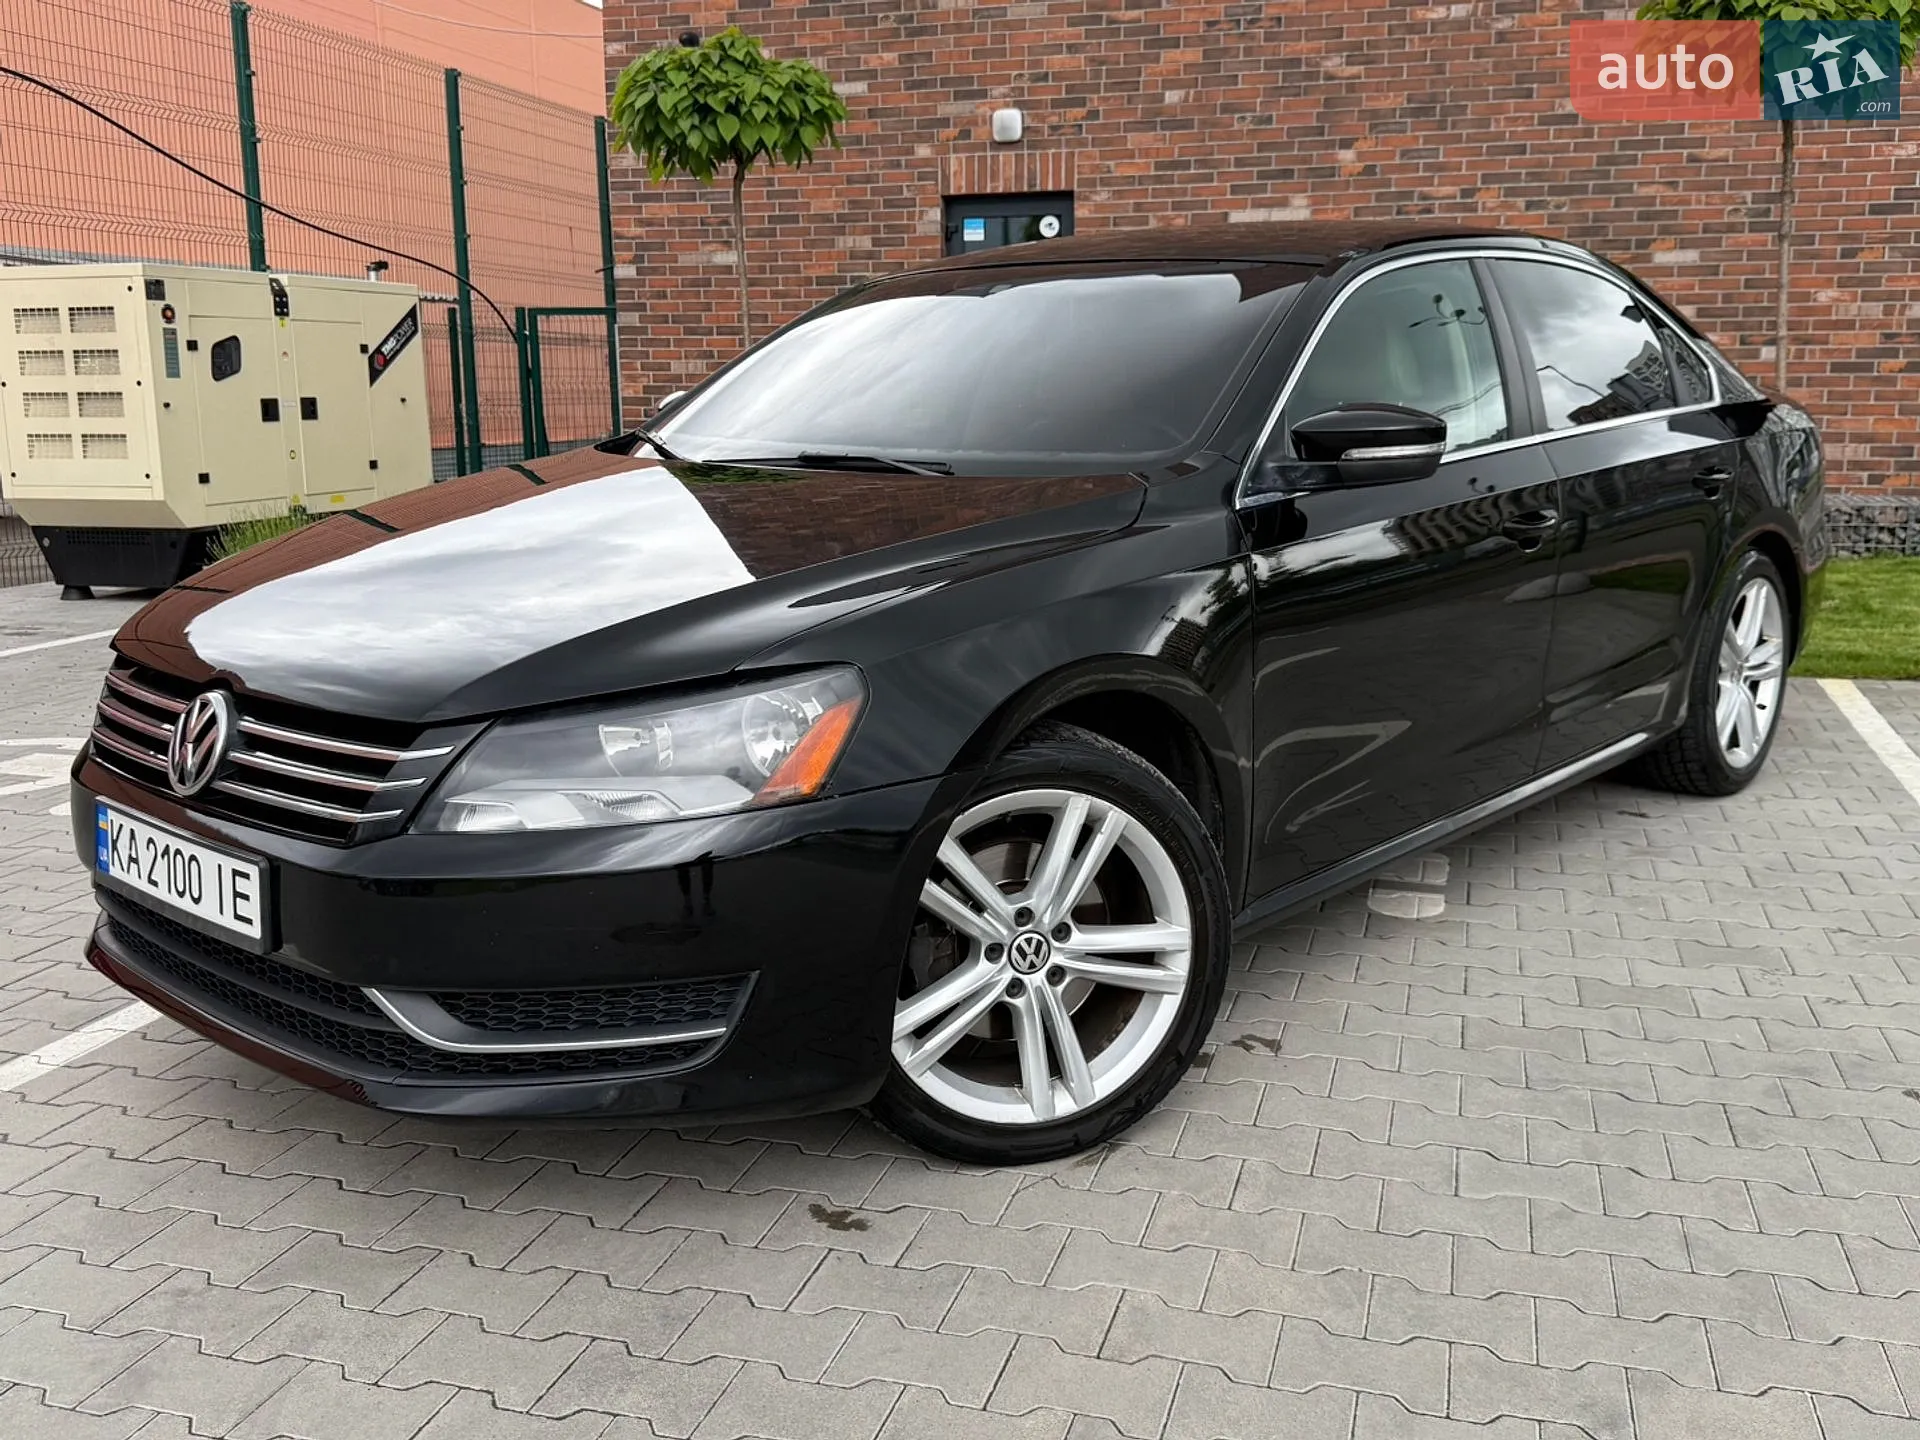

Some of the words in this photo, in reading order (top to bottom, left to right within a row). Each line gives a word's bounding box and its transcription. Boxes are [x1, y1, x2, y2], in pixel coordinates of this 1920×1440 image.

[110, 819, 141, 880] KA
[146, 836, 202, 905] 2100
[217, 863, 254, 926] IE
